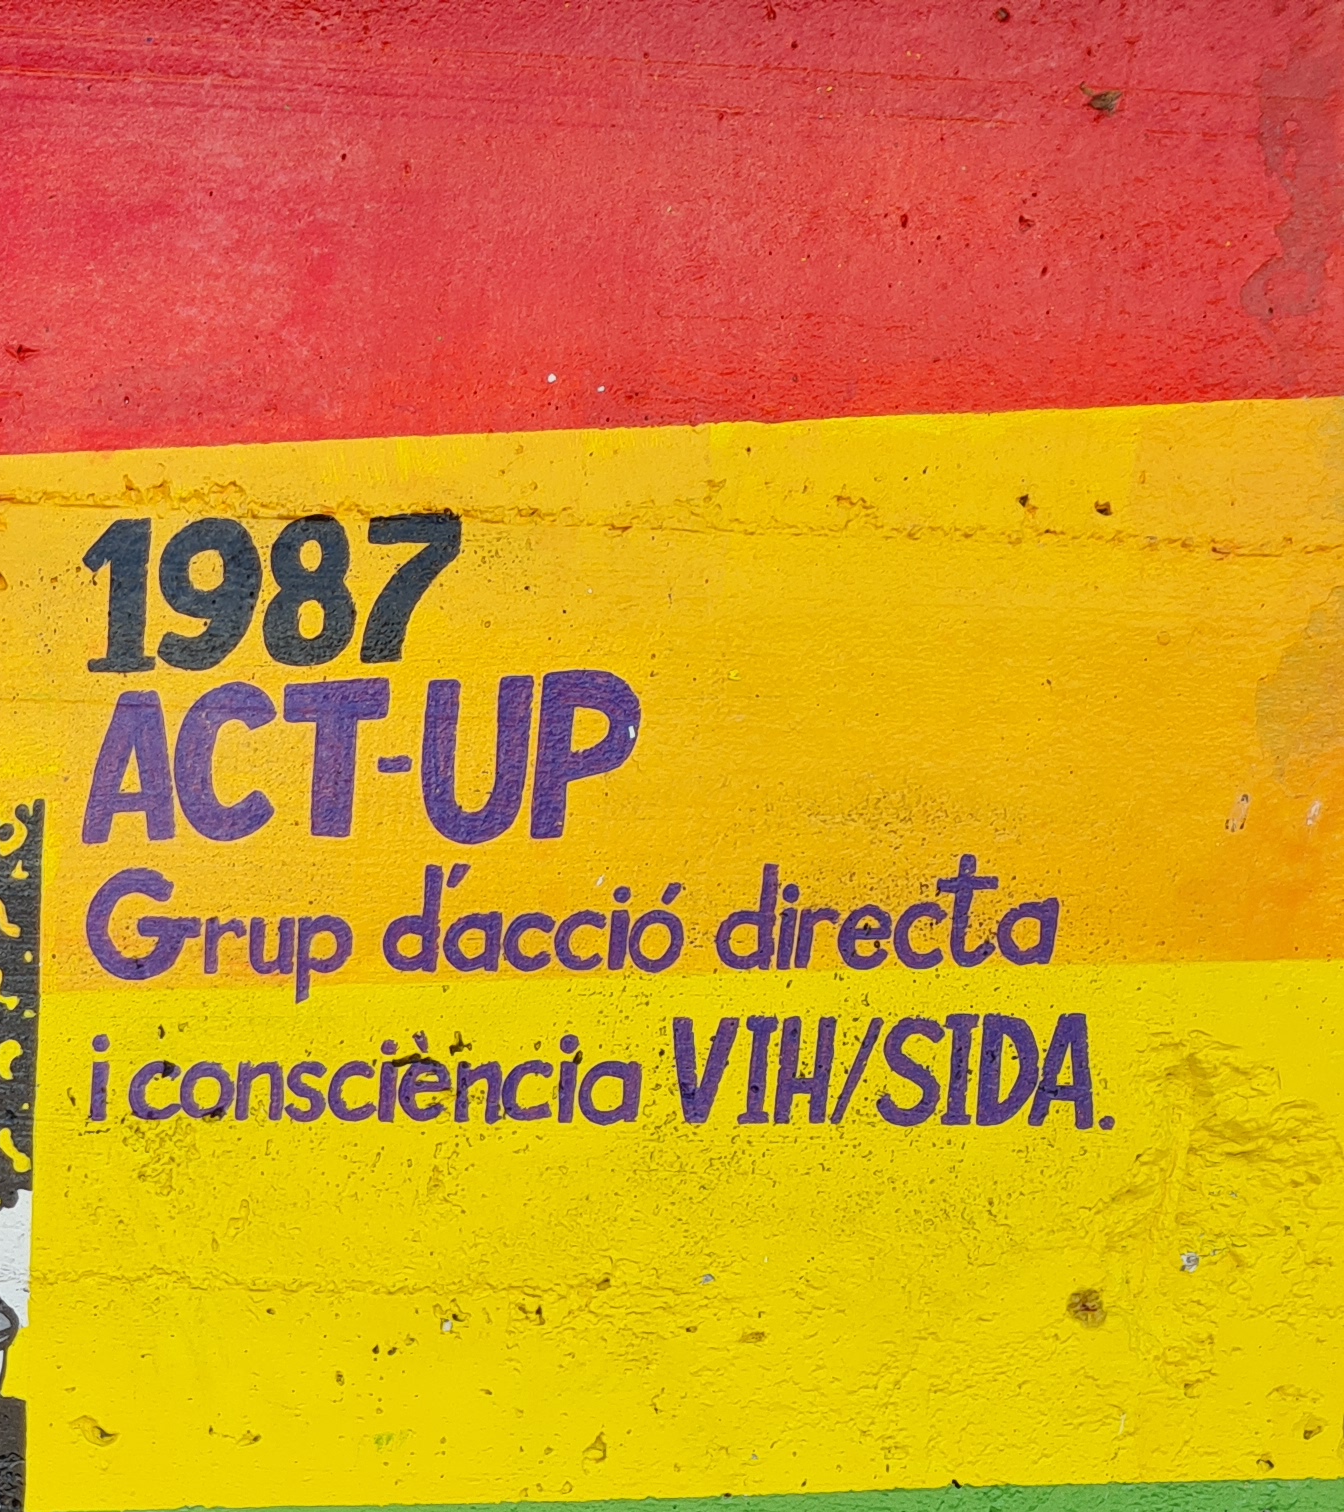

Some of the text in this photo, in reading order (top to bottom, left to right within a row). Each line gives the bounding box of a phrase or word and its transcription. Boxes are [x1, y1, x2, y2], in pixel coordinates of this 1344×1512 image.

[79, 510, 464, 673] 1987
[81, 669, 642, 845] ACT-UP
[84, 867, 353, 1002] Grup
[714, 853, 1061, 971] directa
[127, 1030, 641, 1126] consciència
[672, 1011, 1117, 1132] VIH/SIDA.
